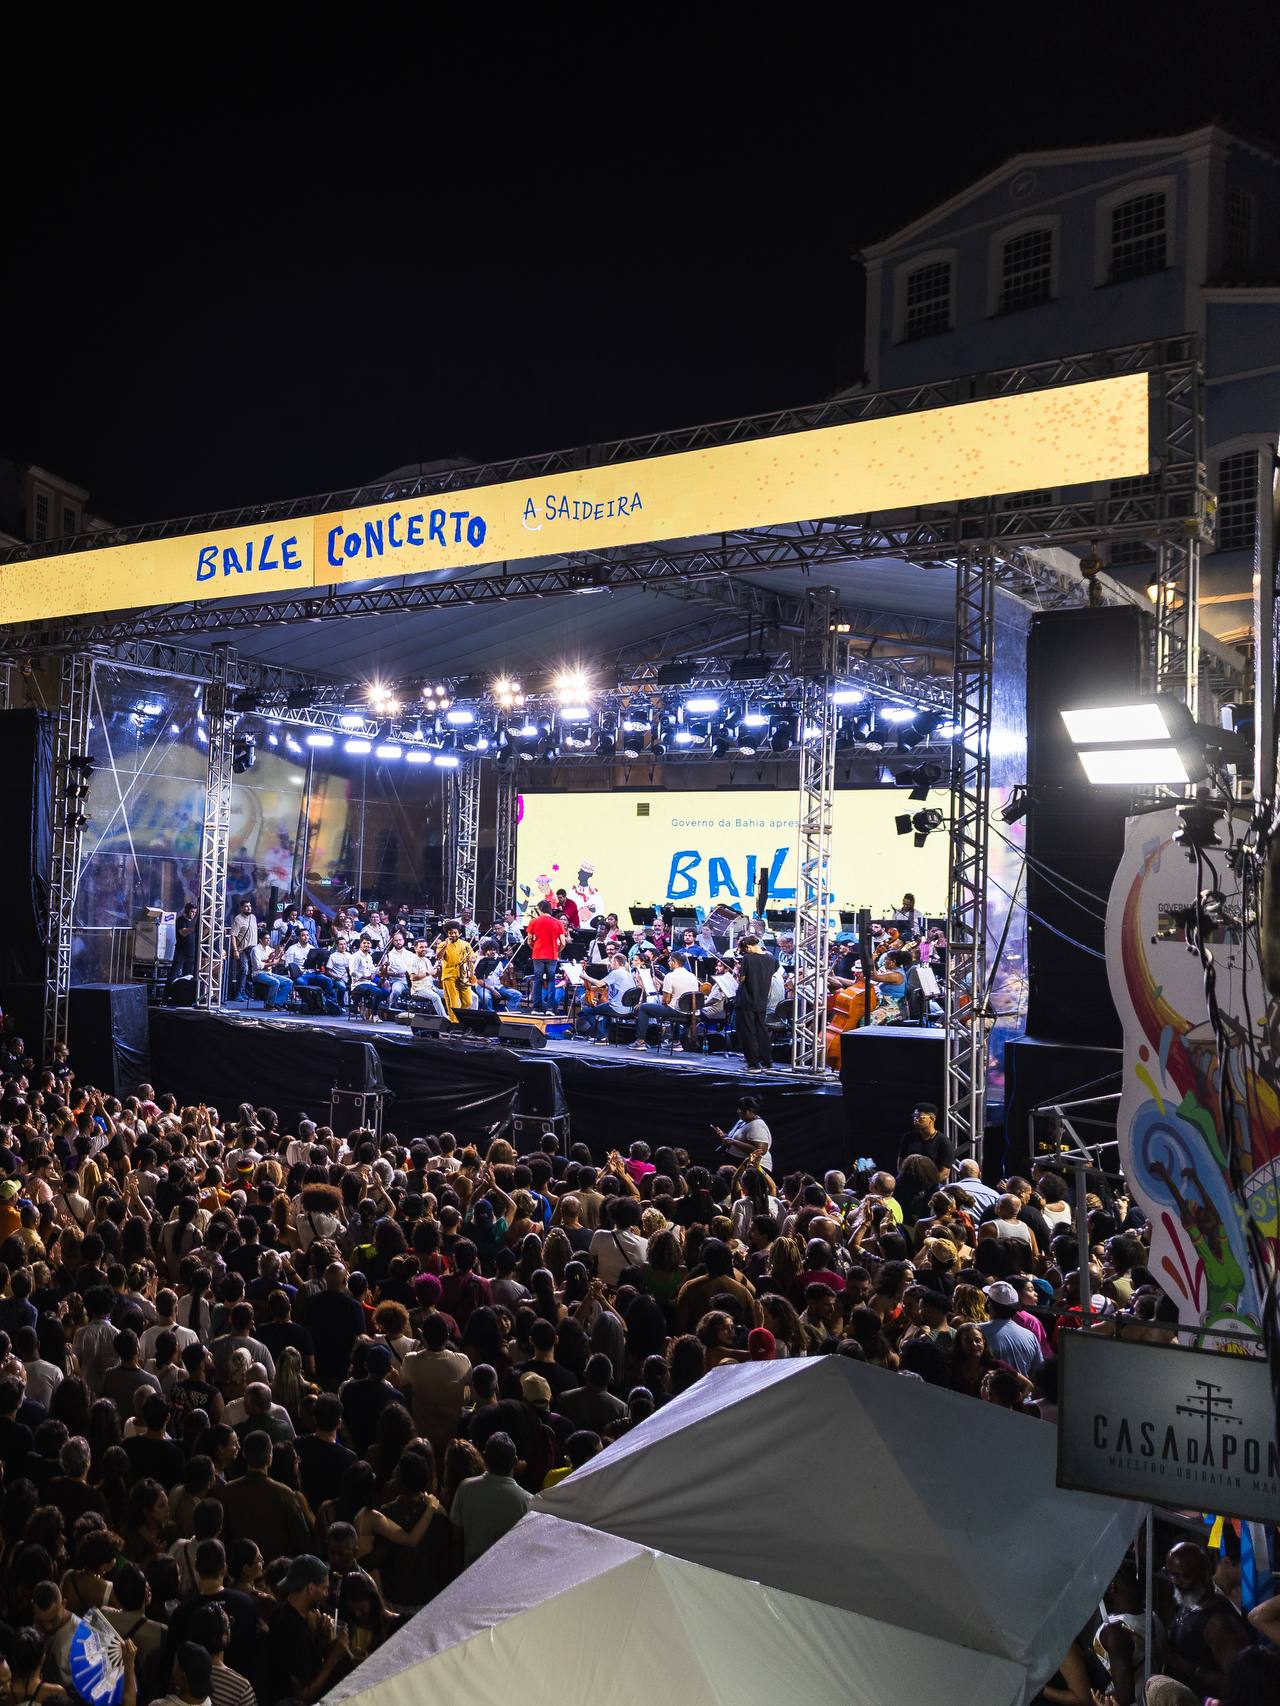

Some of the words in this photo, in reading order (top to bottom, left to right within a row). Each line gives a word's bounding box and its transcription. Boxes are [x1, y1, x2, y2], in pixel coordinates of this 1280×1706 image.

[196, 534, 302, 581] BAILE
[327, 509, 487, 566] CONCERTO
[523, 497, 536, 520] A
[545, 491, 643, 520] SAIDEIRA
[671, 818, 714, 827] Governo
[718, 818, 731, 827] da
[735, 818, 765, 827] Bahia
[769, 819, 810, 829] apres
[1109, 1456, 1165, 1474] MAESTRO
[1177, 1467, 1241, 1488] UBIRATAN
